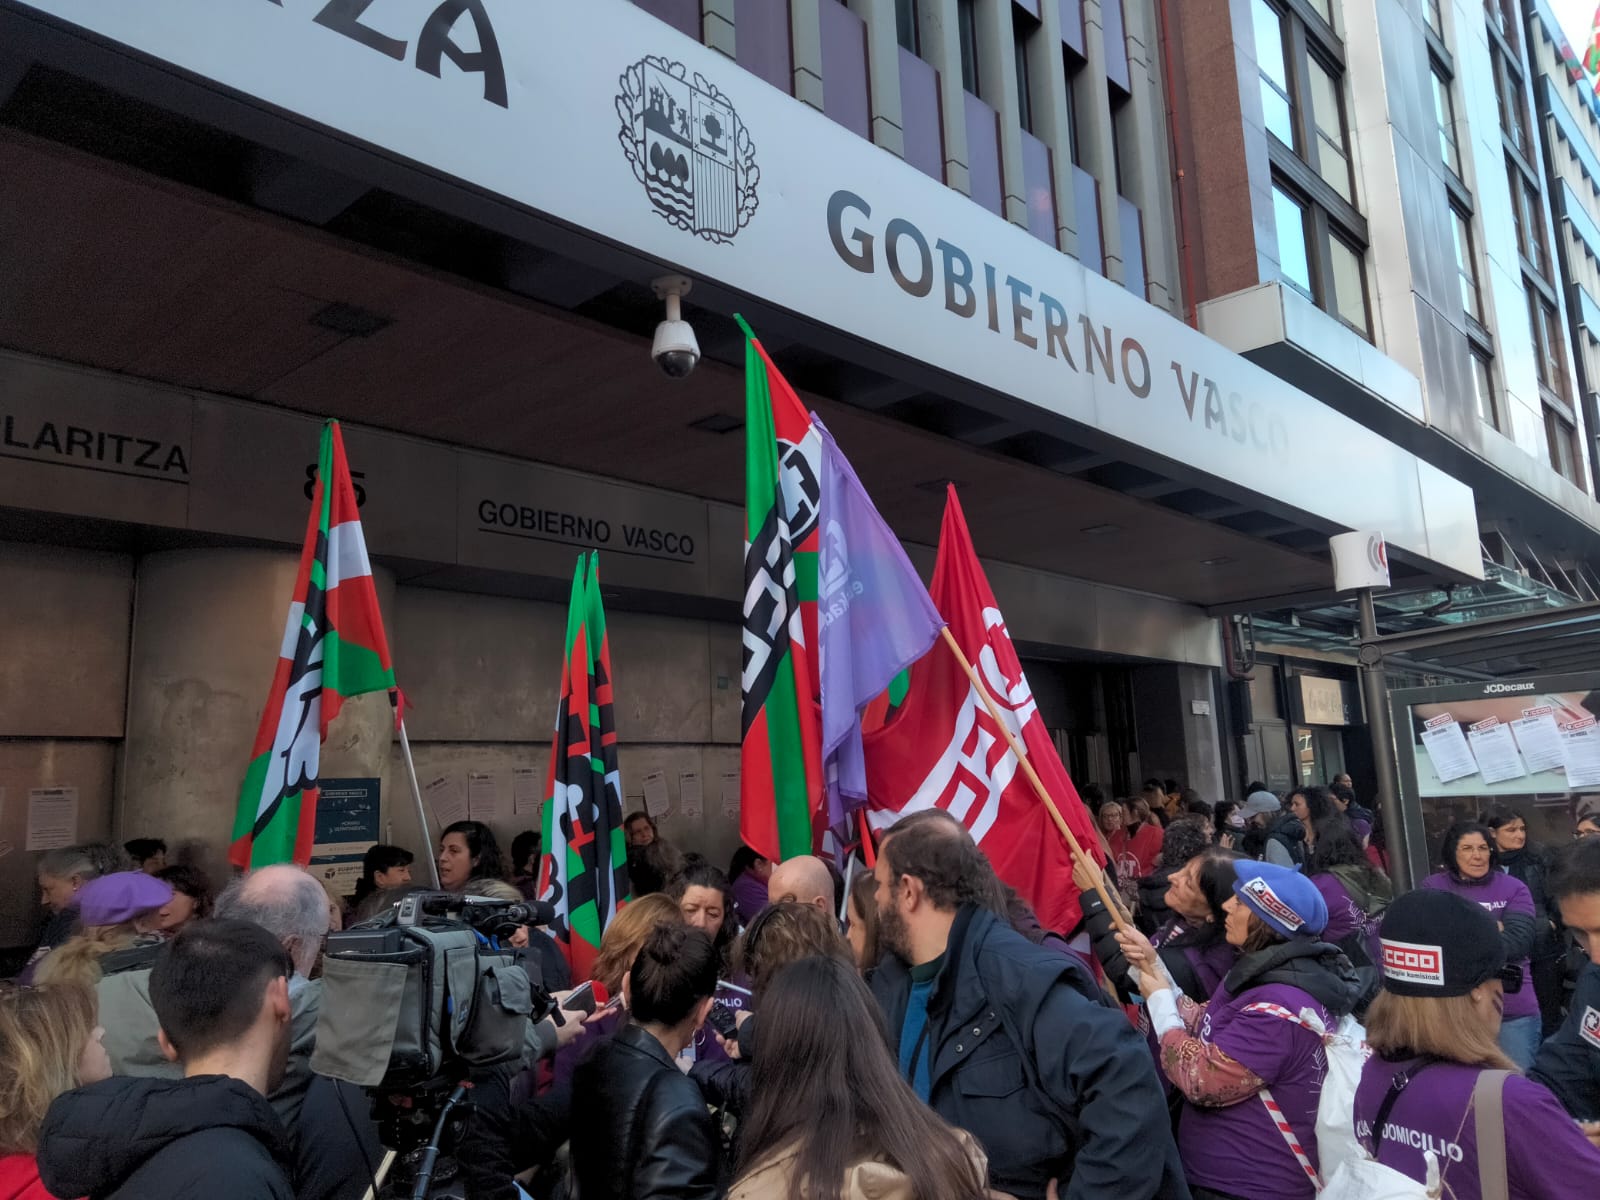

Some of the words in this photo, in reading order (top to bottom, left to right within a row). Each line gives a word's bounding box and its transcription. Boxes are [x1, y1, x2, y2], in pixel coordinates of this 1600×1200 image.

[826, 189, 1152, 400] GOBIERNO
[1171, 360, 1291, 468] VASCO
[477, 498, 611, 544] GOBIERNO
[622, 522, 695, 558] VASCO
[1483, 681, 1536, 695] JCDecaux
[1263, 894, 1299, 923] CCOO
[1385, 949, 1435, 969] CCOO
